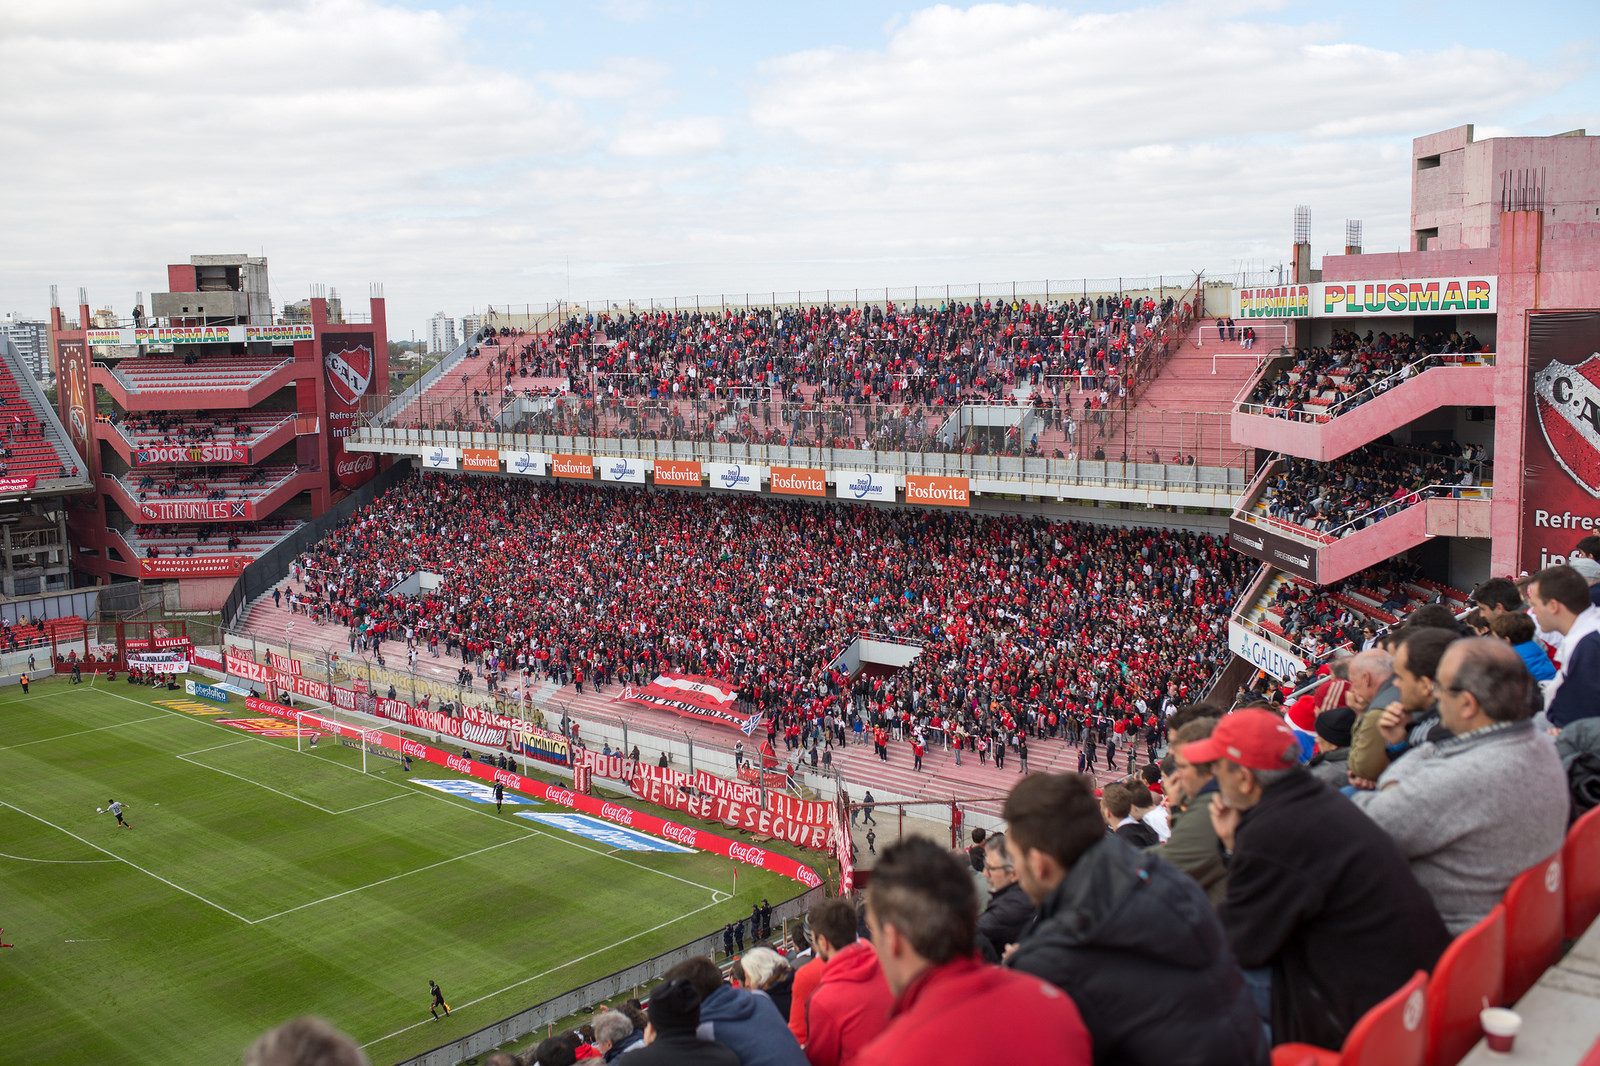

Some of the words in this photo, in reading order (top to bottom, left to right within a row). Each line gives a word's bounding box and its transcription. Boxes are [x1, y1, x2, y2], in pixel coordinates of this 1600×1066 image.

[1241, 285, 1308, 317] PLUSMAR
[1324, 281, 1490, 313] PLUSMAR
[135, 327, 230, 344] PLUSMAR
[247, 326, 313, 341] PLUSMAR
[330, 411, 374, 420] Refrescdo
[148, 448, 189, 462] DOCK
[201, 447, 233, 462] SUD
[463, 454, 498, 468] Fosfovita
[337, 455, 373, 477] Coca-Cola
[553, 459, 592, 475] Fosfovita
[655, 466, 699, 482] Fosfovita
[772, 473, 823, 491] Fosfovita
[857, 478, 868, 486] Total
[907, 482, 966, 501] Fosfovita
[159, 503, 229, 520] TRIBUNALES
[155, 638, 191, 647] LLAVALLOL
[226, 657, 267, 683] EZEIZA
[1252, 642, 1297, 682] GALENO
[275, 672, 295, 692] AMOR
[258, 703, 285, 717] Coca-Cola
[637, 693, 657, 703] HOY
[678, 701, 717, 717] QUIERO
[462, 706, 478, 723] KM
[479, 710, 492, 726] 30
[511, 718, 533, 733] 26
[462, 720, 507, 745] Quilmes
[402, 740, 426, 758] Coca-Cola
[446, 755, 471, 774] Coca-Cola
[573, 747, 636, 781] PADUA
[494, 770, 521, 790] Coca-Cola
[698, 772, 762, 806] ALMAGRO
[545, 786, 575, 807] Coca-Cola
[632, 774, 713, 817] SIEMPRE
[717, 798, 741, 824] TE
[601, 802, 633, 825] Coca-Cola
[767, 790, 833, 825] CALZADA
[662, 821, 697, 845] Coca-Cola
[729, 841, 766, 867] Coca-Cola
